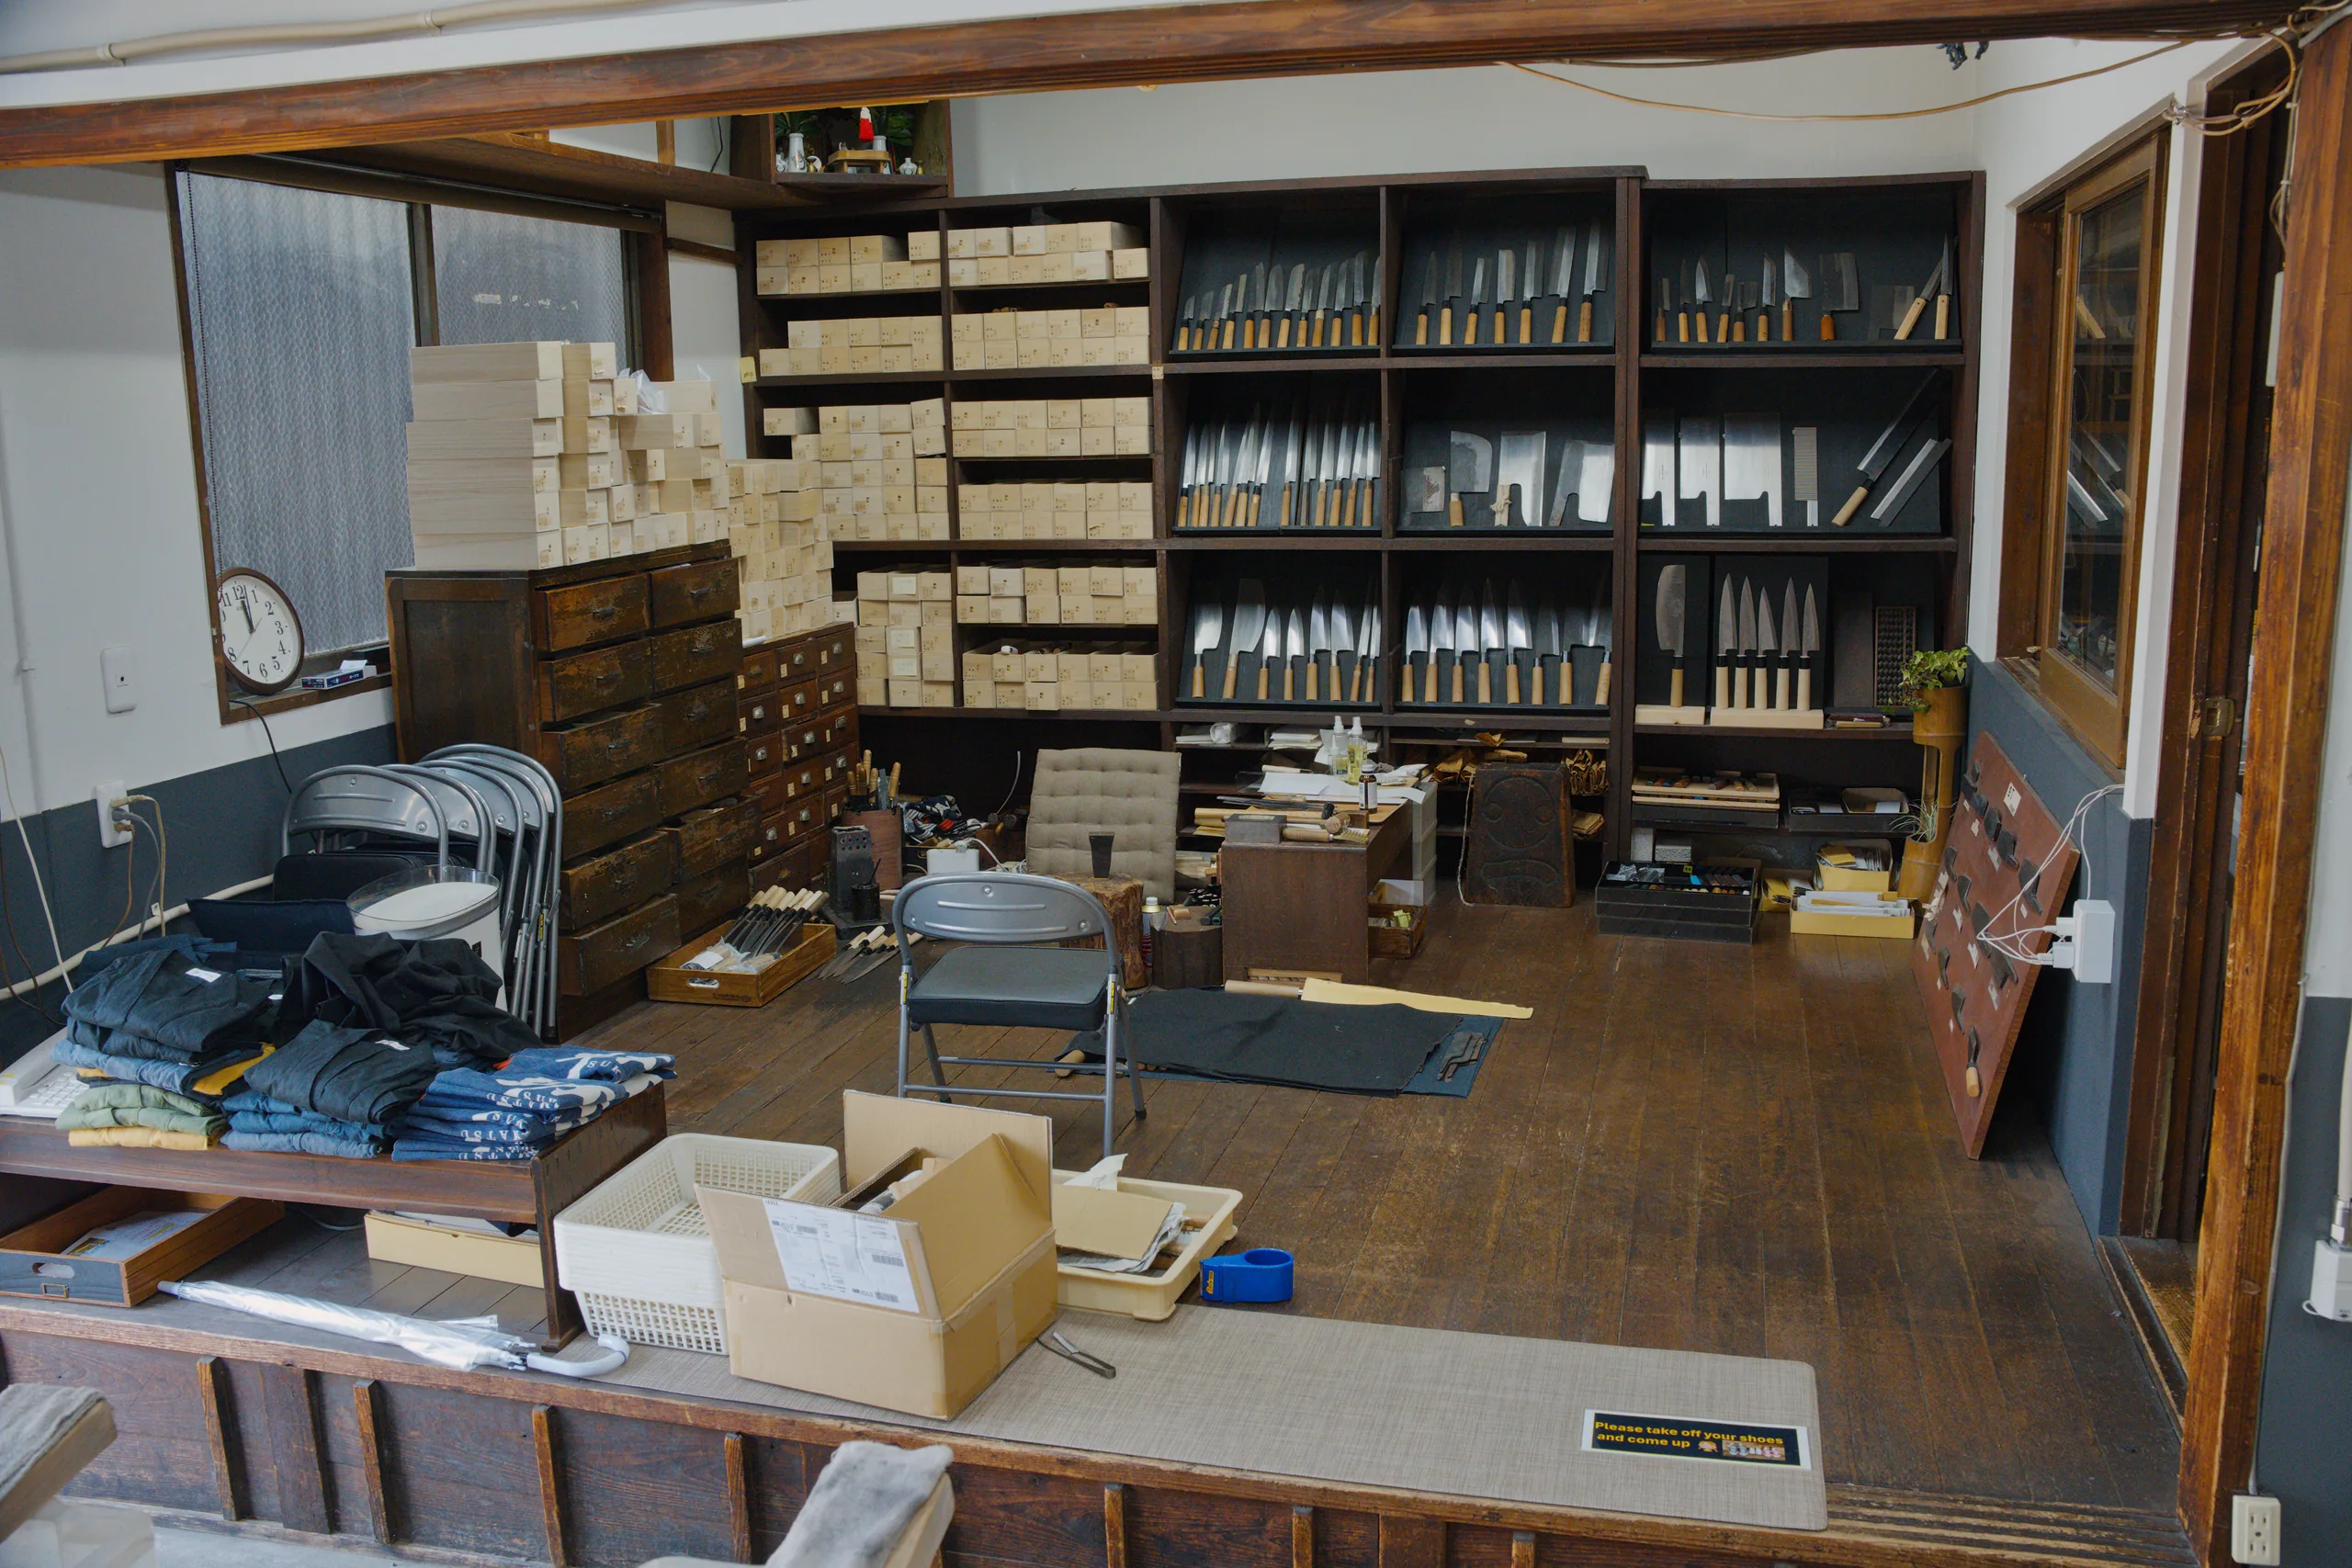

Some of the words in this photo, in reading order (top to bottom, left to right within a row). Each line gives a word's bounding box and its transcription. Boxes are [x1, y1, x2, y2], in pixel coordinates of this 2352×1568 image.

[221, 592, 232, 607] 11
[232, 585, 245, 600] 12
[252, 590, 259, 604] 1
[265, 601, 275, 615] 2
[275, 620, 284, 636] 3
[227, 647, 237, 662] 8
[278, 639, 287, 655] 4
[243, 660, 250, 675] 7
[259, 662, 268, 678] 6
[272, 656, 280, 671] 5
[1595, 1422, 1644, 1433] Please
[1646, 1427, 1678, 1436] take
[1681, 1429, 1702, 1438] off
[1704, 1432, 1736, 1441] your
[1739, 1435, 1783, 1445] shoes
[1597, 1433, 1624, 1442] and
[1627, 1437, 1668, 1446] come
[1672, 1440, 1690, 1449] up
